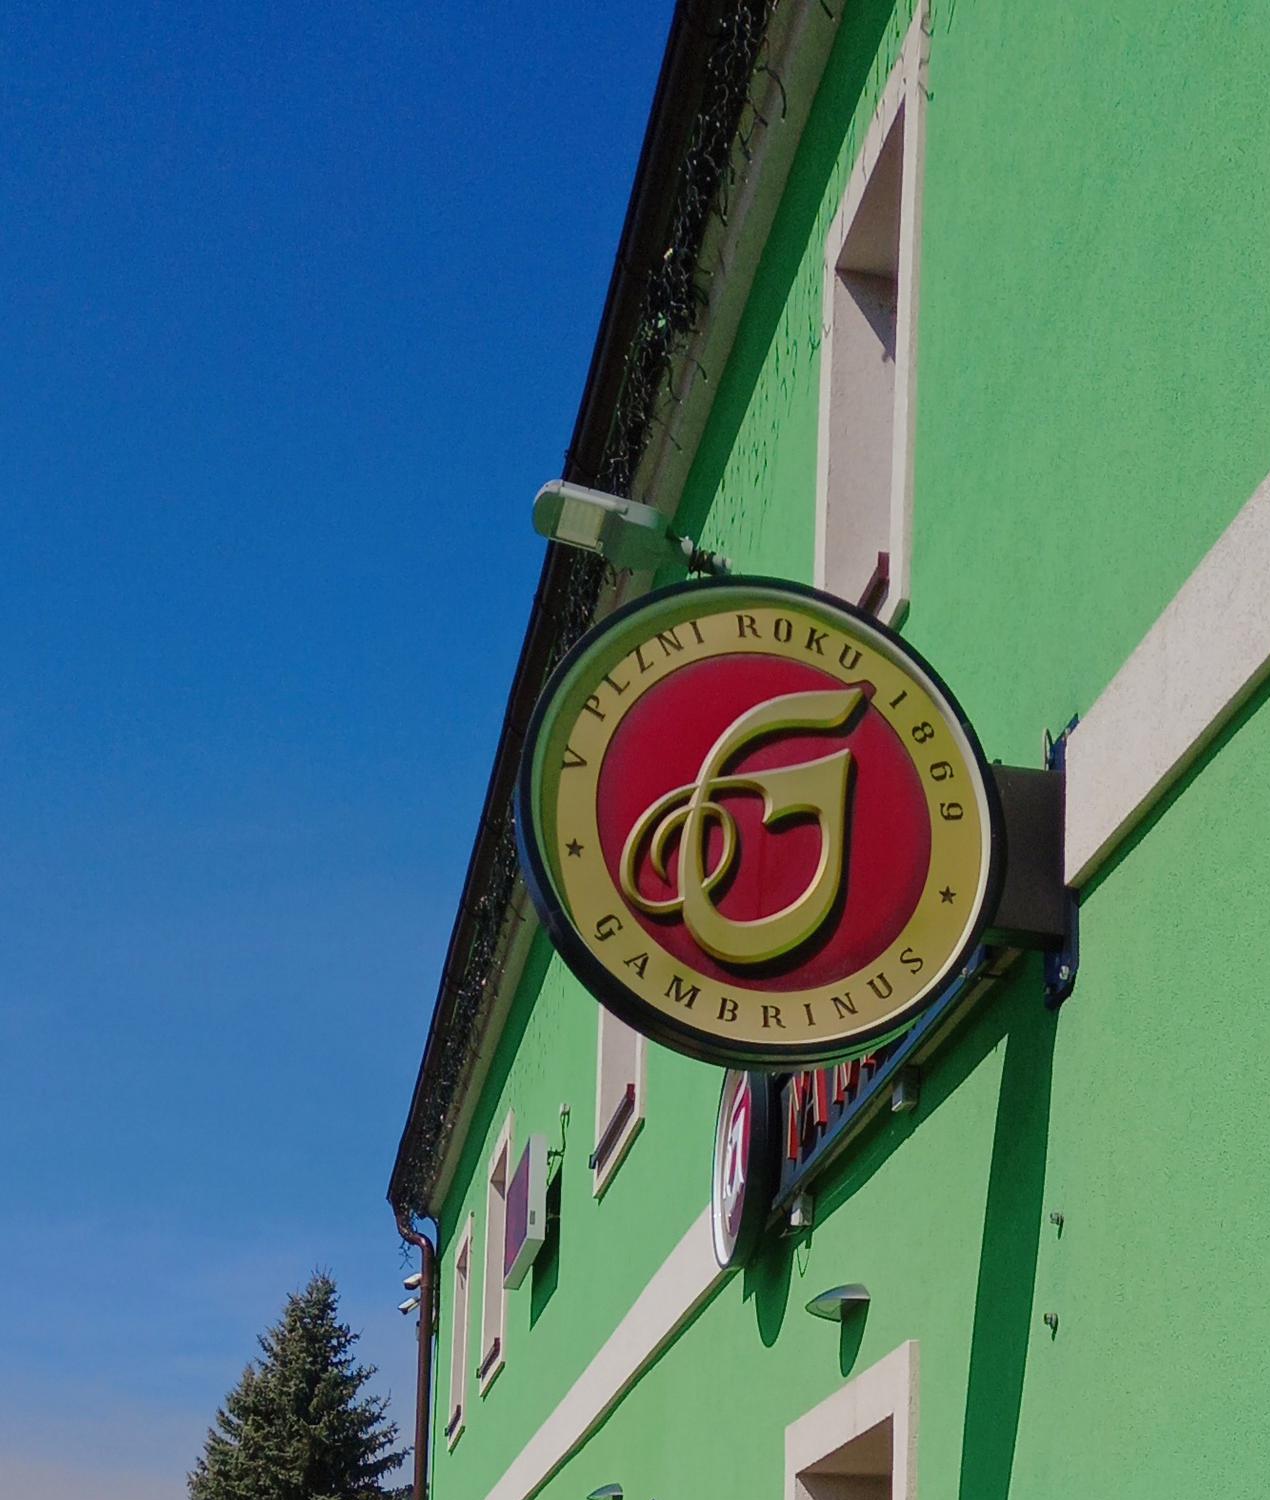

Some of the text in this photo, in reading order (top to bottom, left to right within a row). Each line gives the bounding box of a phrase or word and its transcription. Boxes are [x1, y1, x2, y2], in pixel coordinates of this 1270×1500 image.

[561, 613, 964, 822] V PLZNI ROKU 1869
[594, 912, 925, 1030] GAMBRINUS
